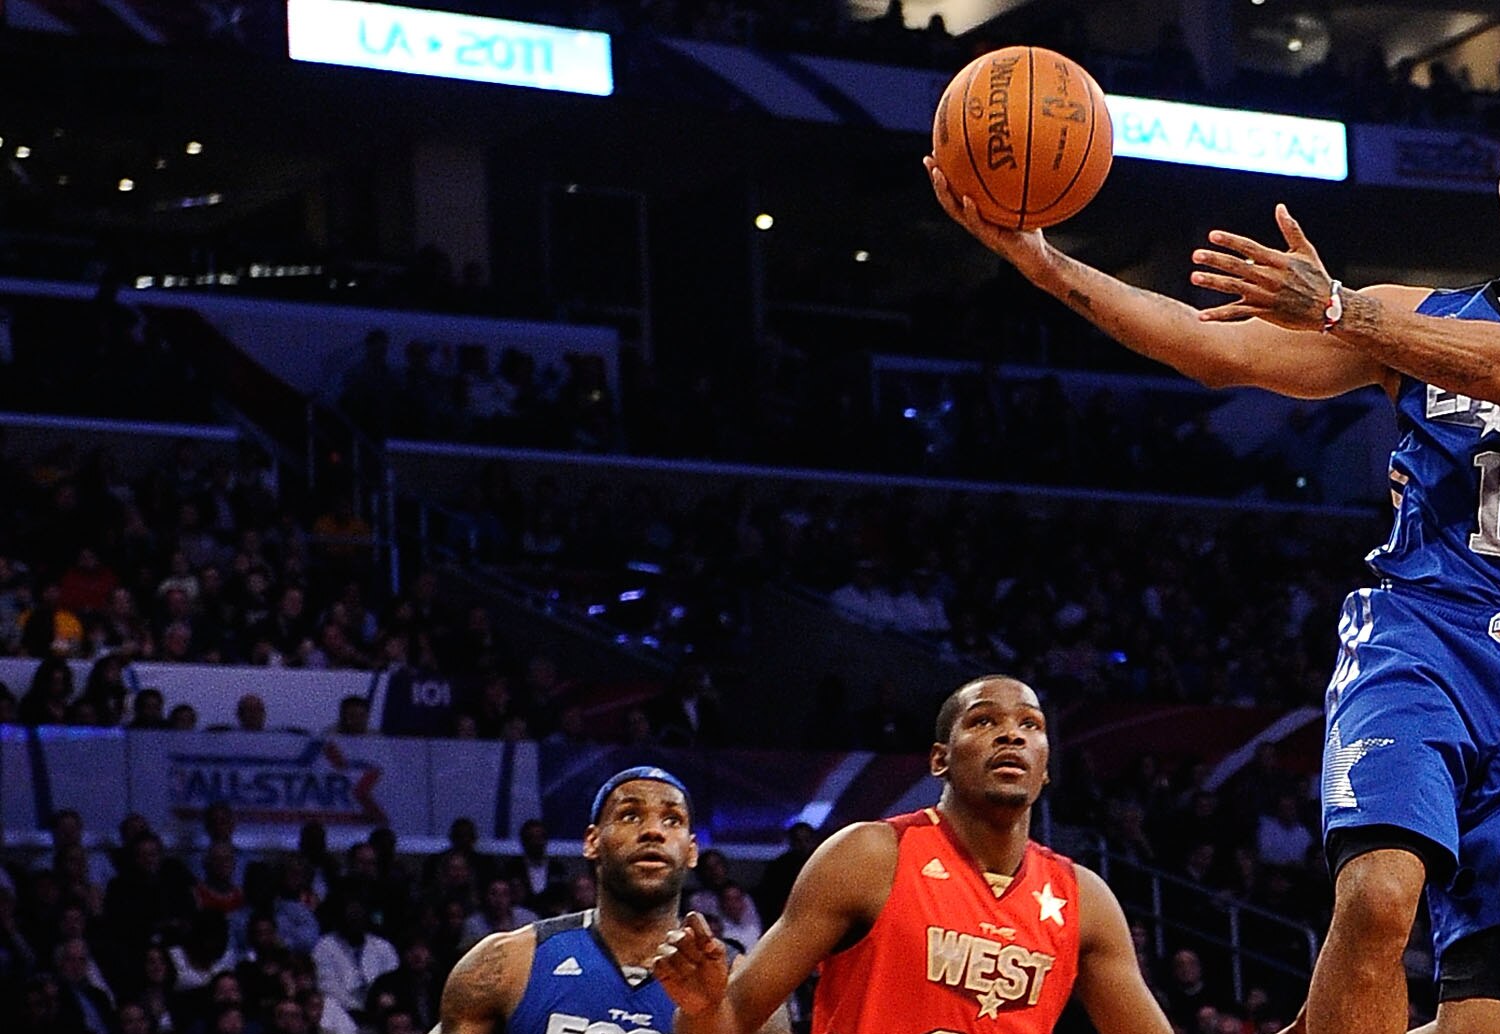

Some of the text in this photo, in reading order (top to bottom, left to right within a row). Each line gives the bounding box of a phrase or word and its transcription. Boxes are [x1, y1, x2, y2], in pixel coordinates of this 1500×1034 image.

[454, 29, 555, 76] 2011
[987, 55, 1020, 170] SPALDING
[926, 925, 1057, 1007] WEST
